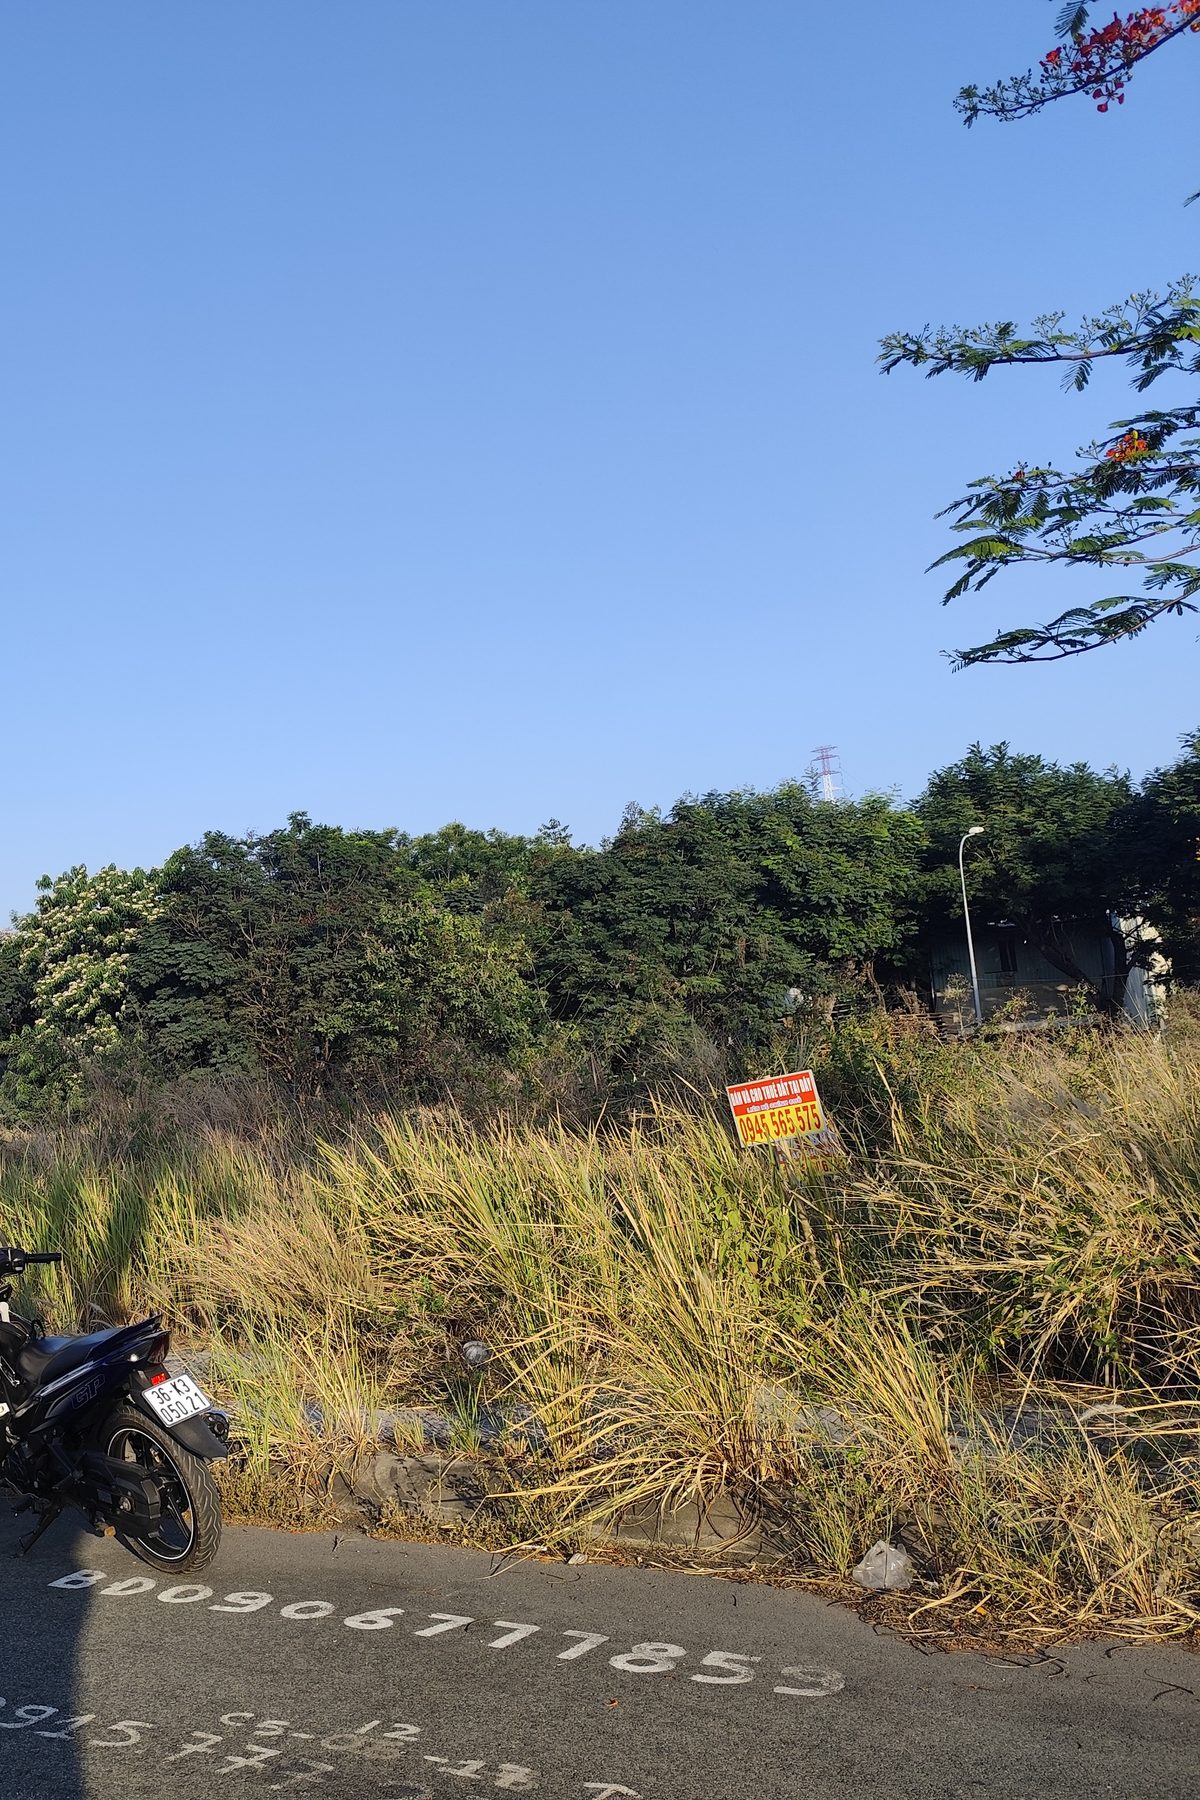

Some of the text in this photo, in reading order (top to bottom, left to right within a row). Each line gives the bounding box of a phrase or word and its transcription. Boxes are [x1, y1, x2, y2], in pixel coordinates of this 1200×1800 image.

[739, 1103, 821, 1142] 0945 565 575
[151, 1378, 191, 1405] 36-K3
[160, 1392, 206, 1423] 050.21
